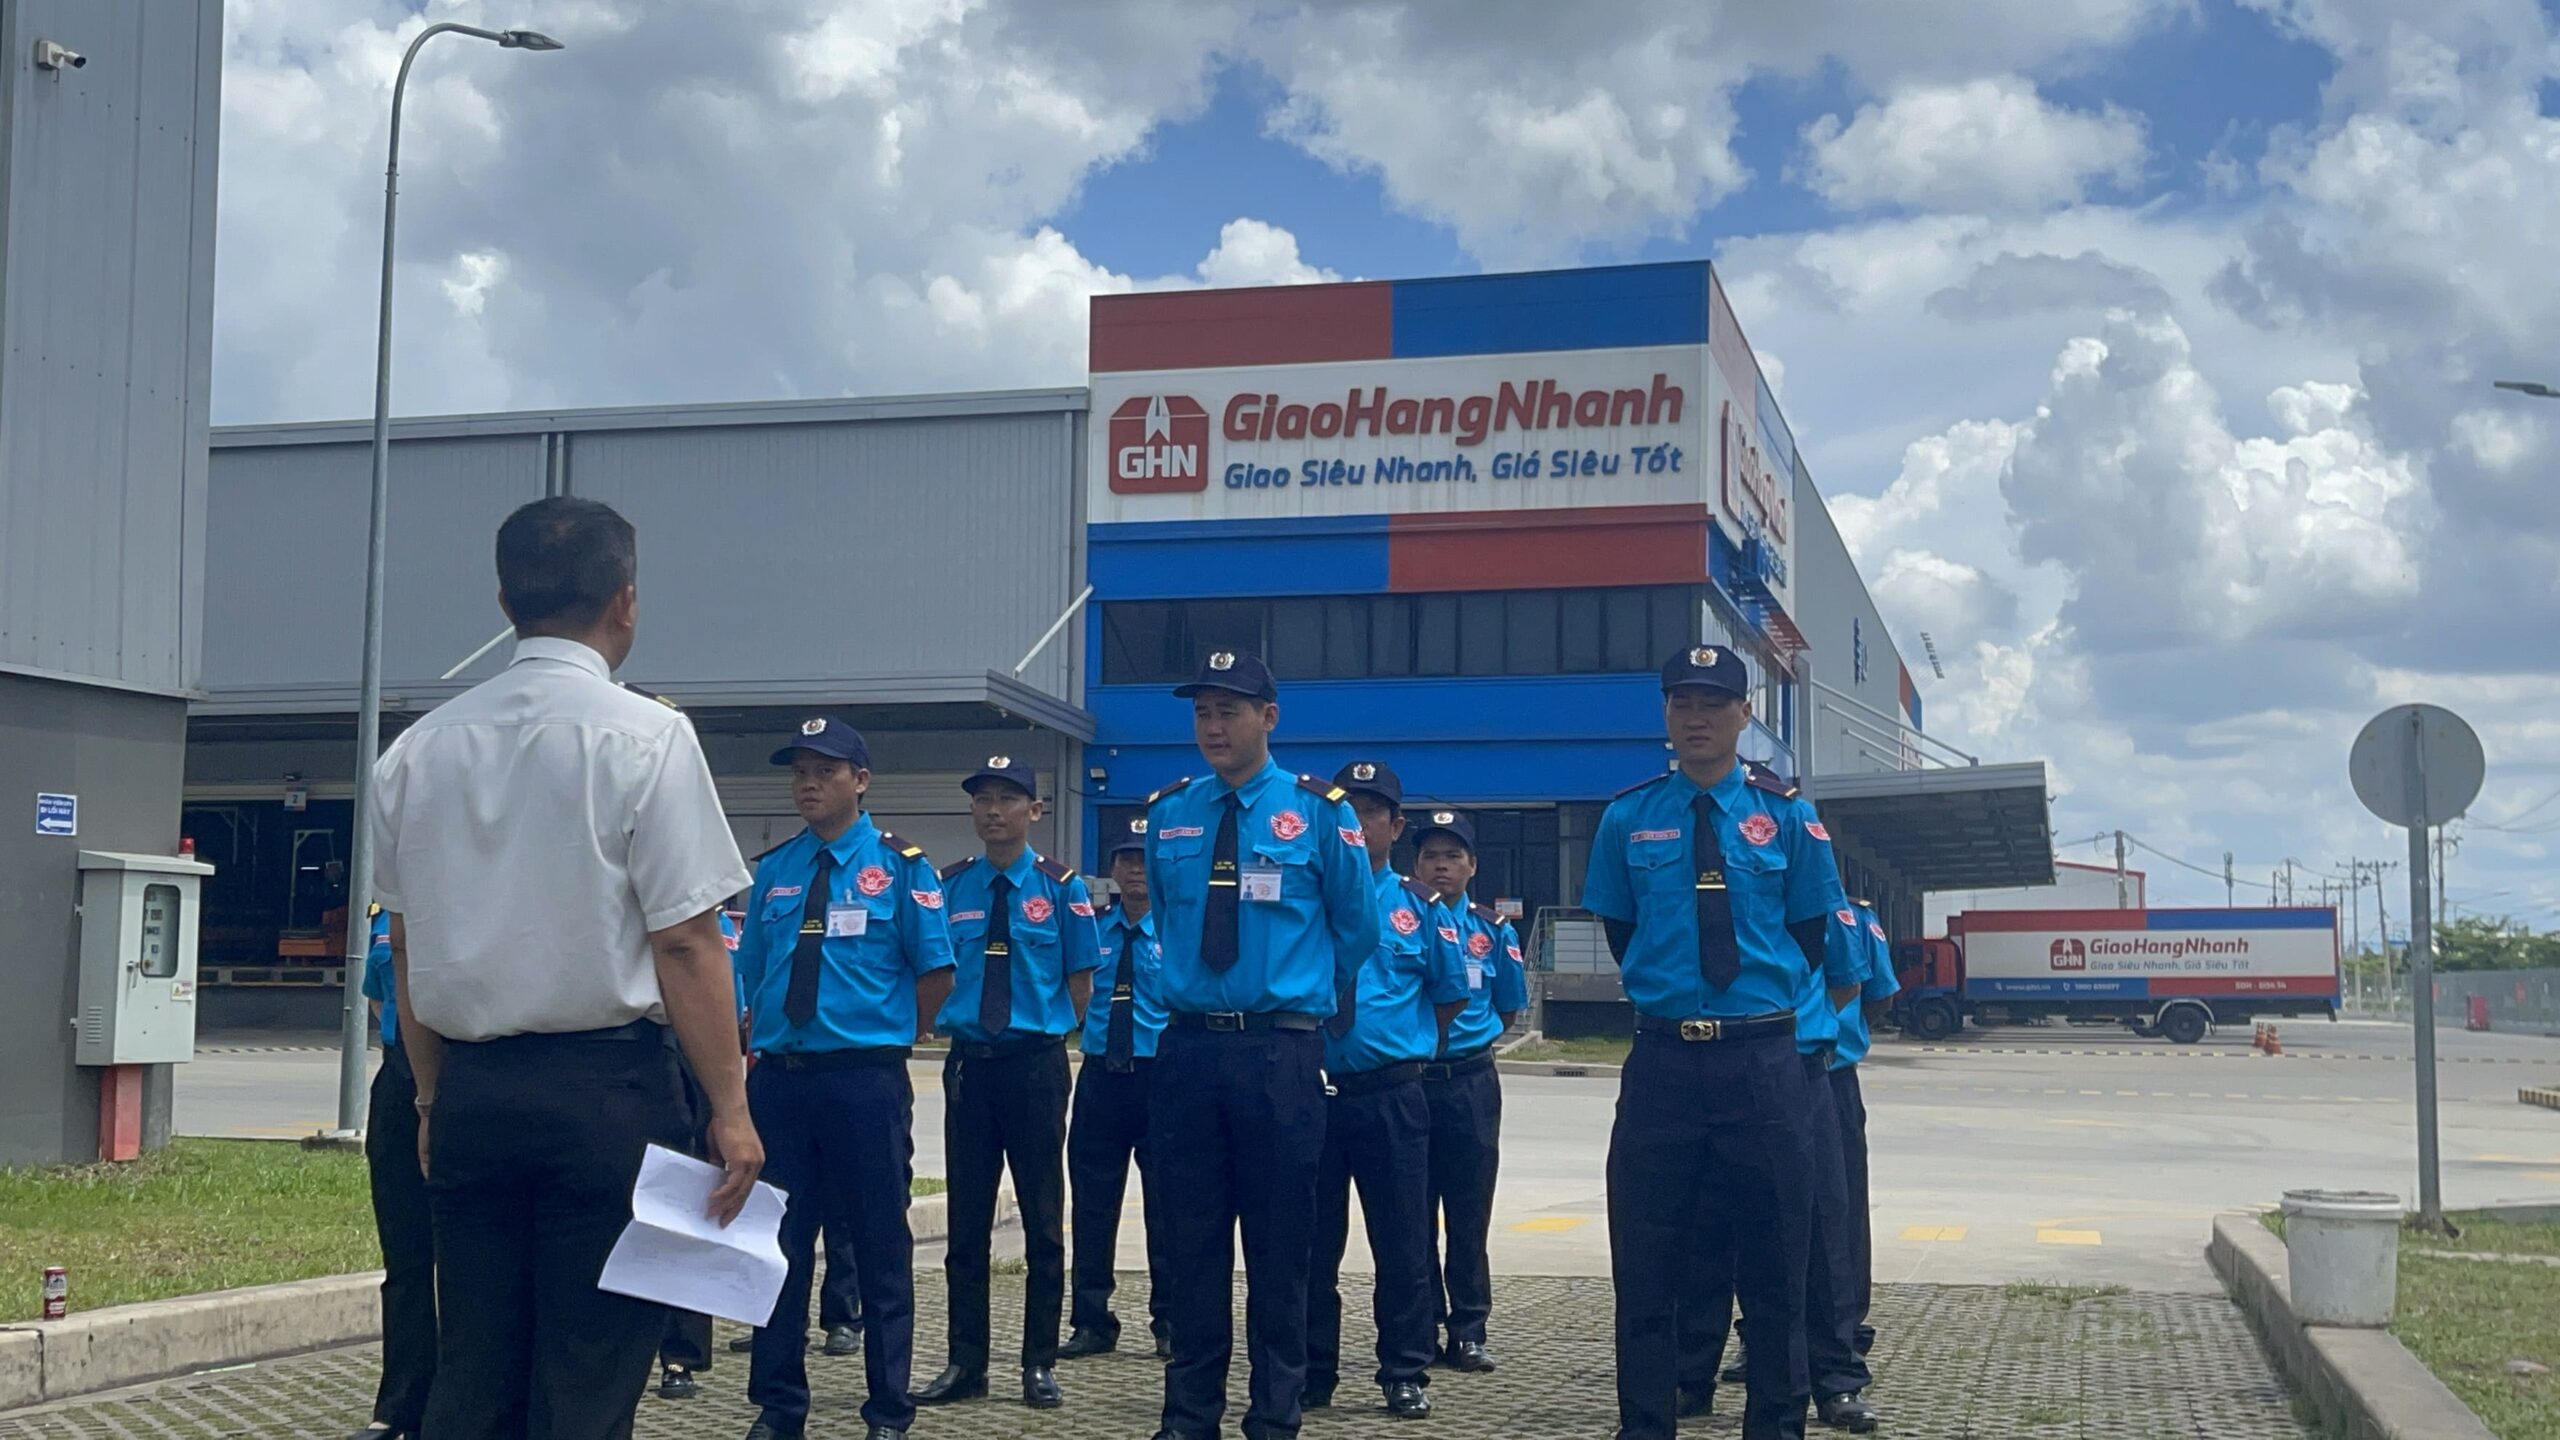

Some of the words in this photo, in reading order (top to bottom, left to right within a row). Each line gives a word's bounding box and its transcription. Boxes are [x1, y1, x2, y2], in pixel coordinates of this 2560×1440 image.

[1223, 373, 1684, 447] GiaoHangNhanh
[1119, 445, 1198, 479] GHN
[1224, 461, 1290, 489] Giao
[1300, 457, 1365, 487] Siêu
[1374, 455, 1478, 485] Nhanh,
[1492, 449, 1540, 479] Giá
[1550, 446, 1619, 478] Siêu
[1631, 442, 1684, 475] Tốt
[2053, 954, 2083, 967] GHN
[2090, 937, 2249, 958] GiaoHangNhanh
[2090, 960, 2114, 970] Giao
